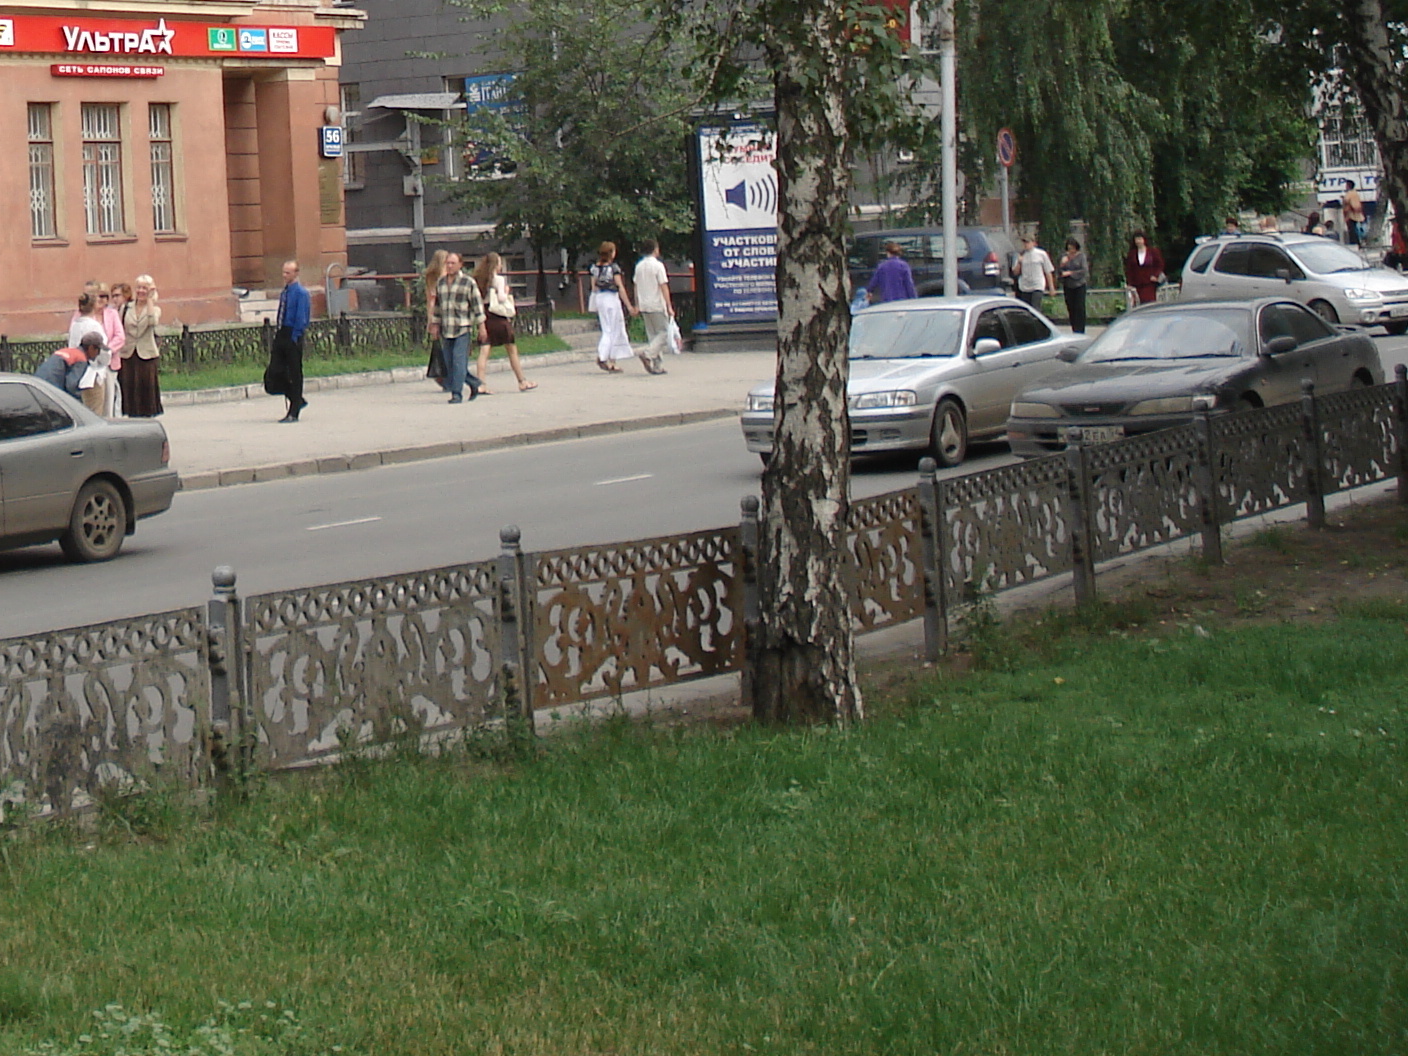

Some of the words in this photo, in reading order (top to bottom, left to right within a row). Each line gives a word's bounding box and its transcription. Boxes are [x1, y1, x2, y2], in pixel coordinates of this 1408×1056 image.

[62, 25, 157, 54] УЛЬТРА
[58, 65, 84, 73] СЕТЬ
[133, 67, 164, 75] СВЯЗИ
[326, 130, 340, 143] 56
[723, 247, 740, 257] ОТ
[743, 246, 776, 256] СЛОВ
